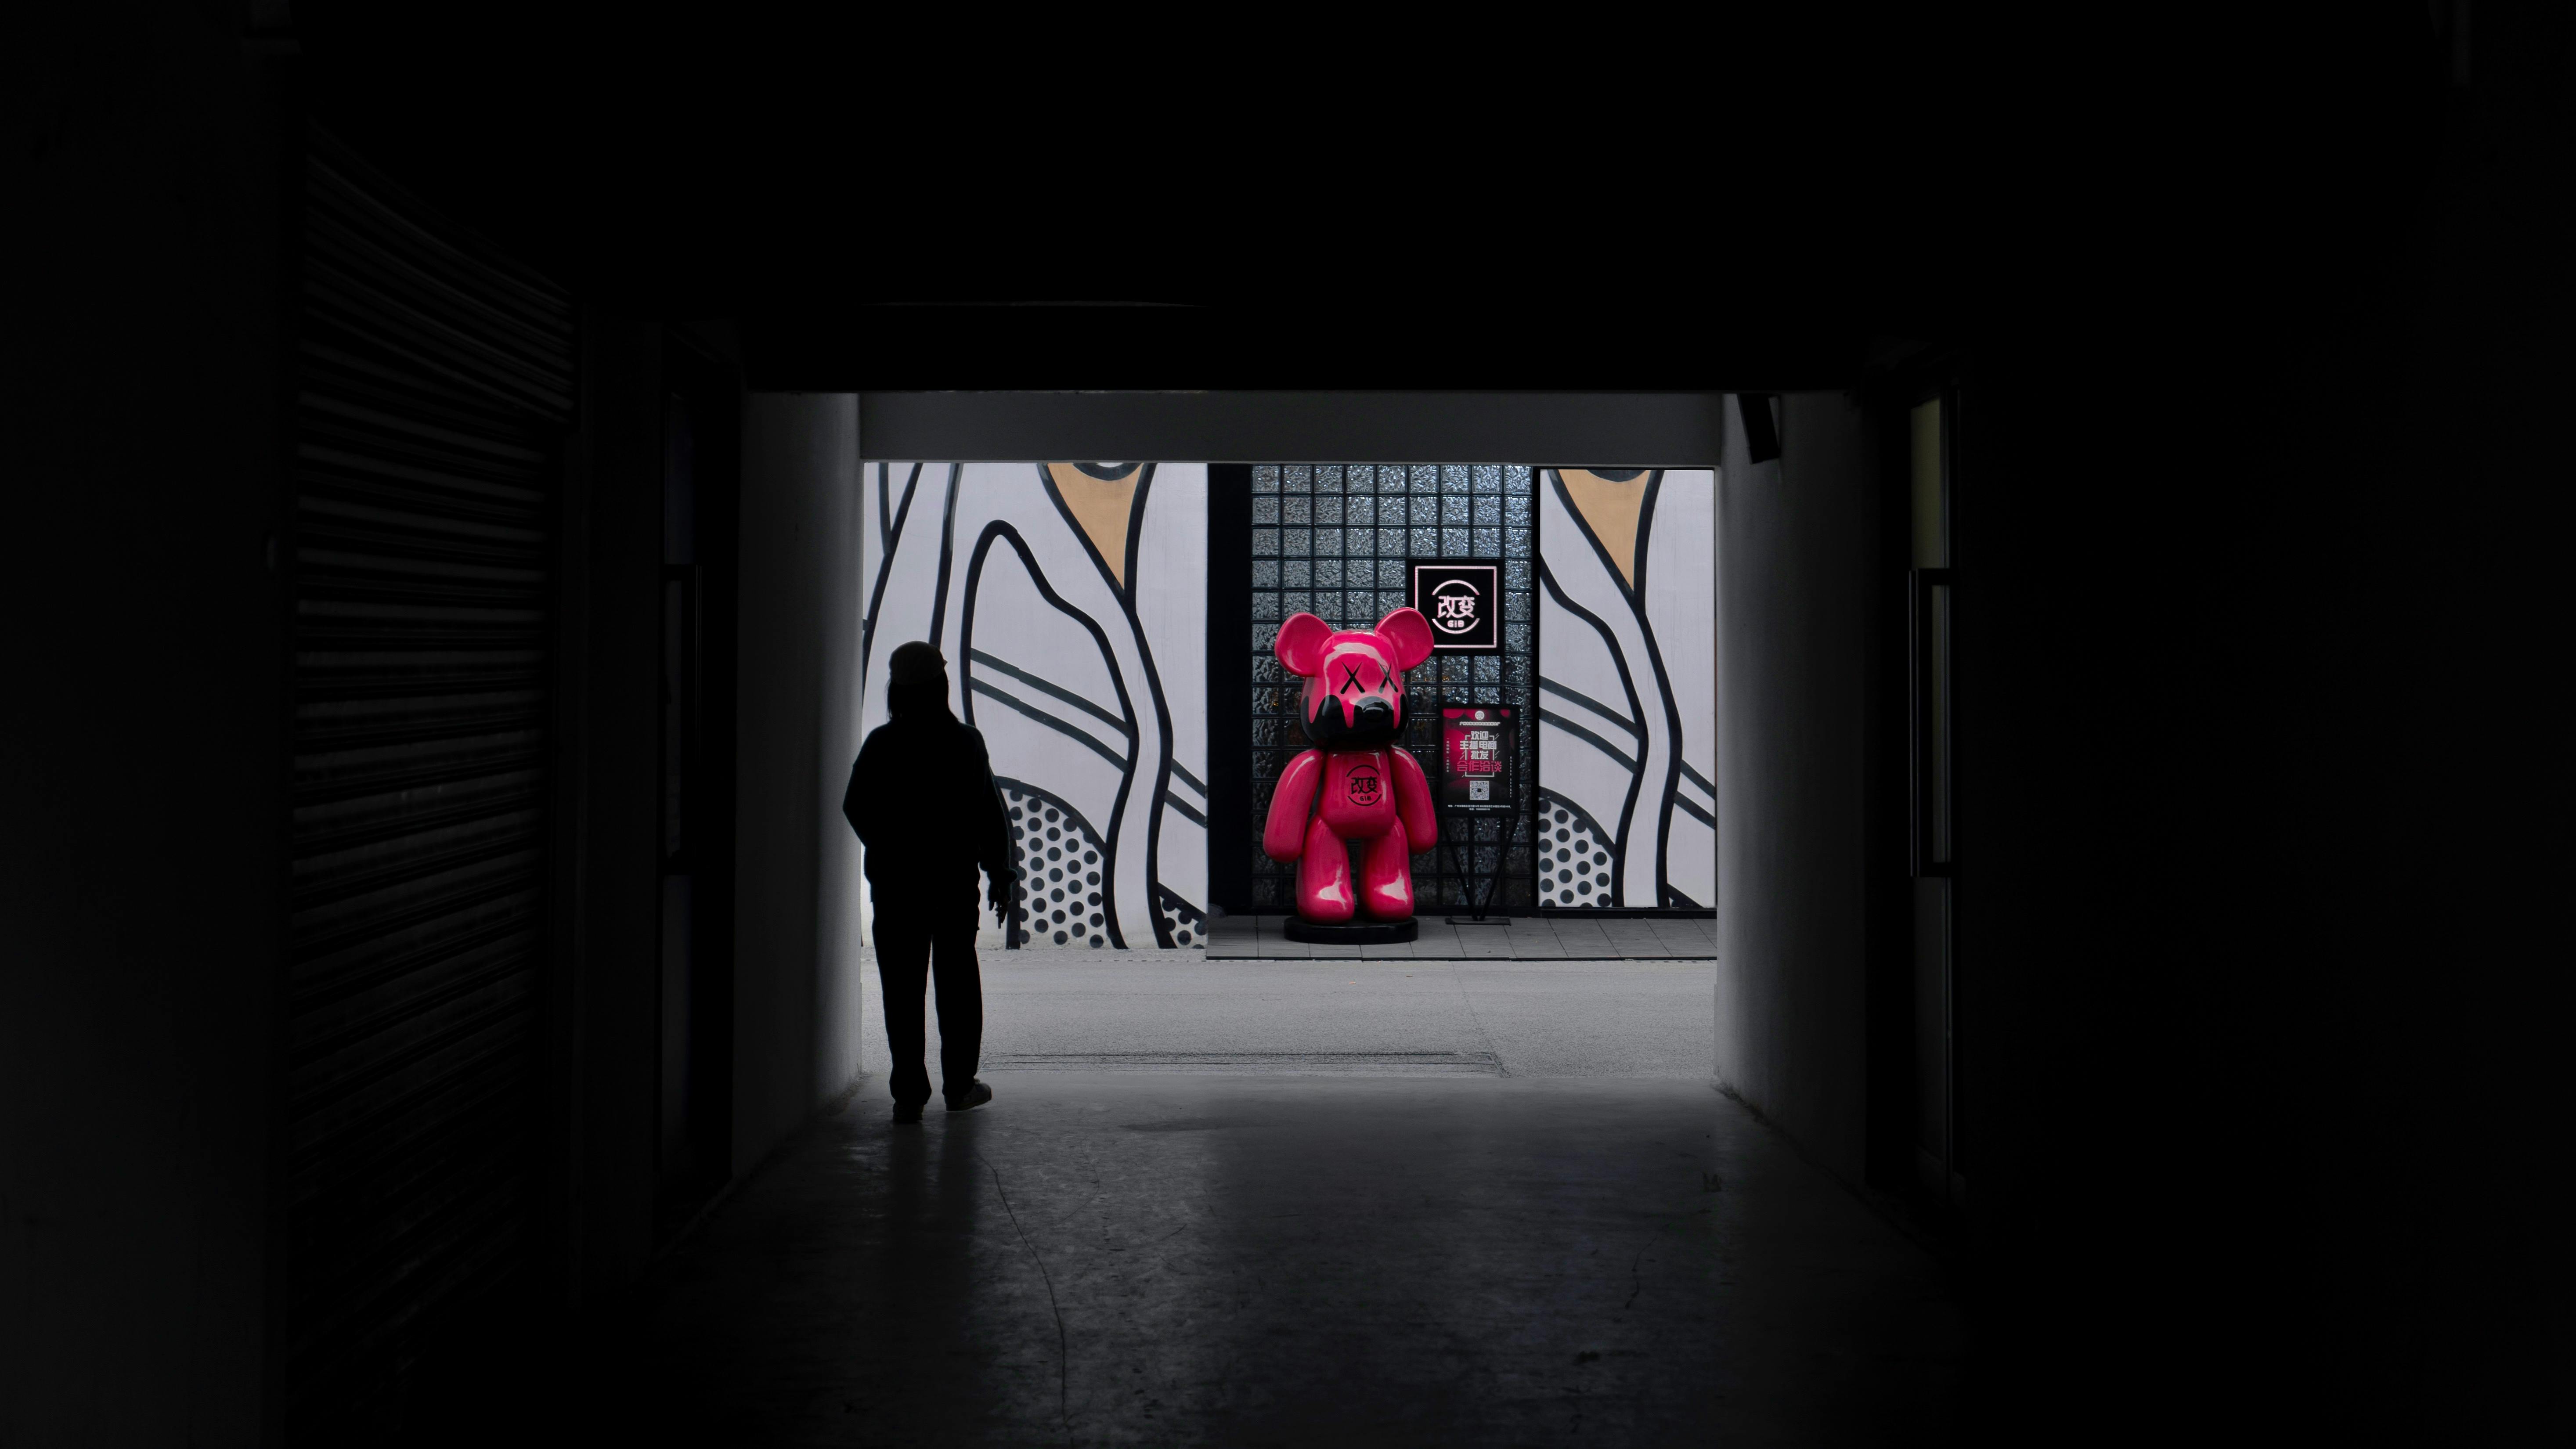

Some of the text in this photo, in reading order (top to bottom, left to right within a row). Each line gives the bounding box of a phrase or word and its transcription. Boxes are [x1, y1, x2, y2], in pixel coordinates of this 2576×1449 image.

[1437, 595, 1476, 618] 改变
[1471, 731, 1489, 740] 欢迎
[1460, 741, 1497, 750] 主播电商
[1471, 750, 1489, 760] 批发
[1457, 761, 1502, 772] 合作洽谈
[1351, 776, 1378, 794] 改变
